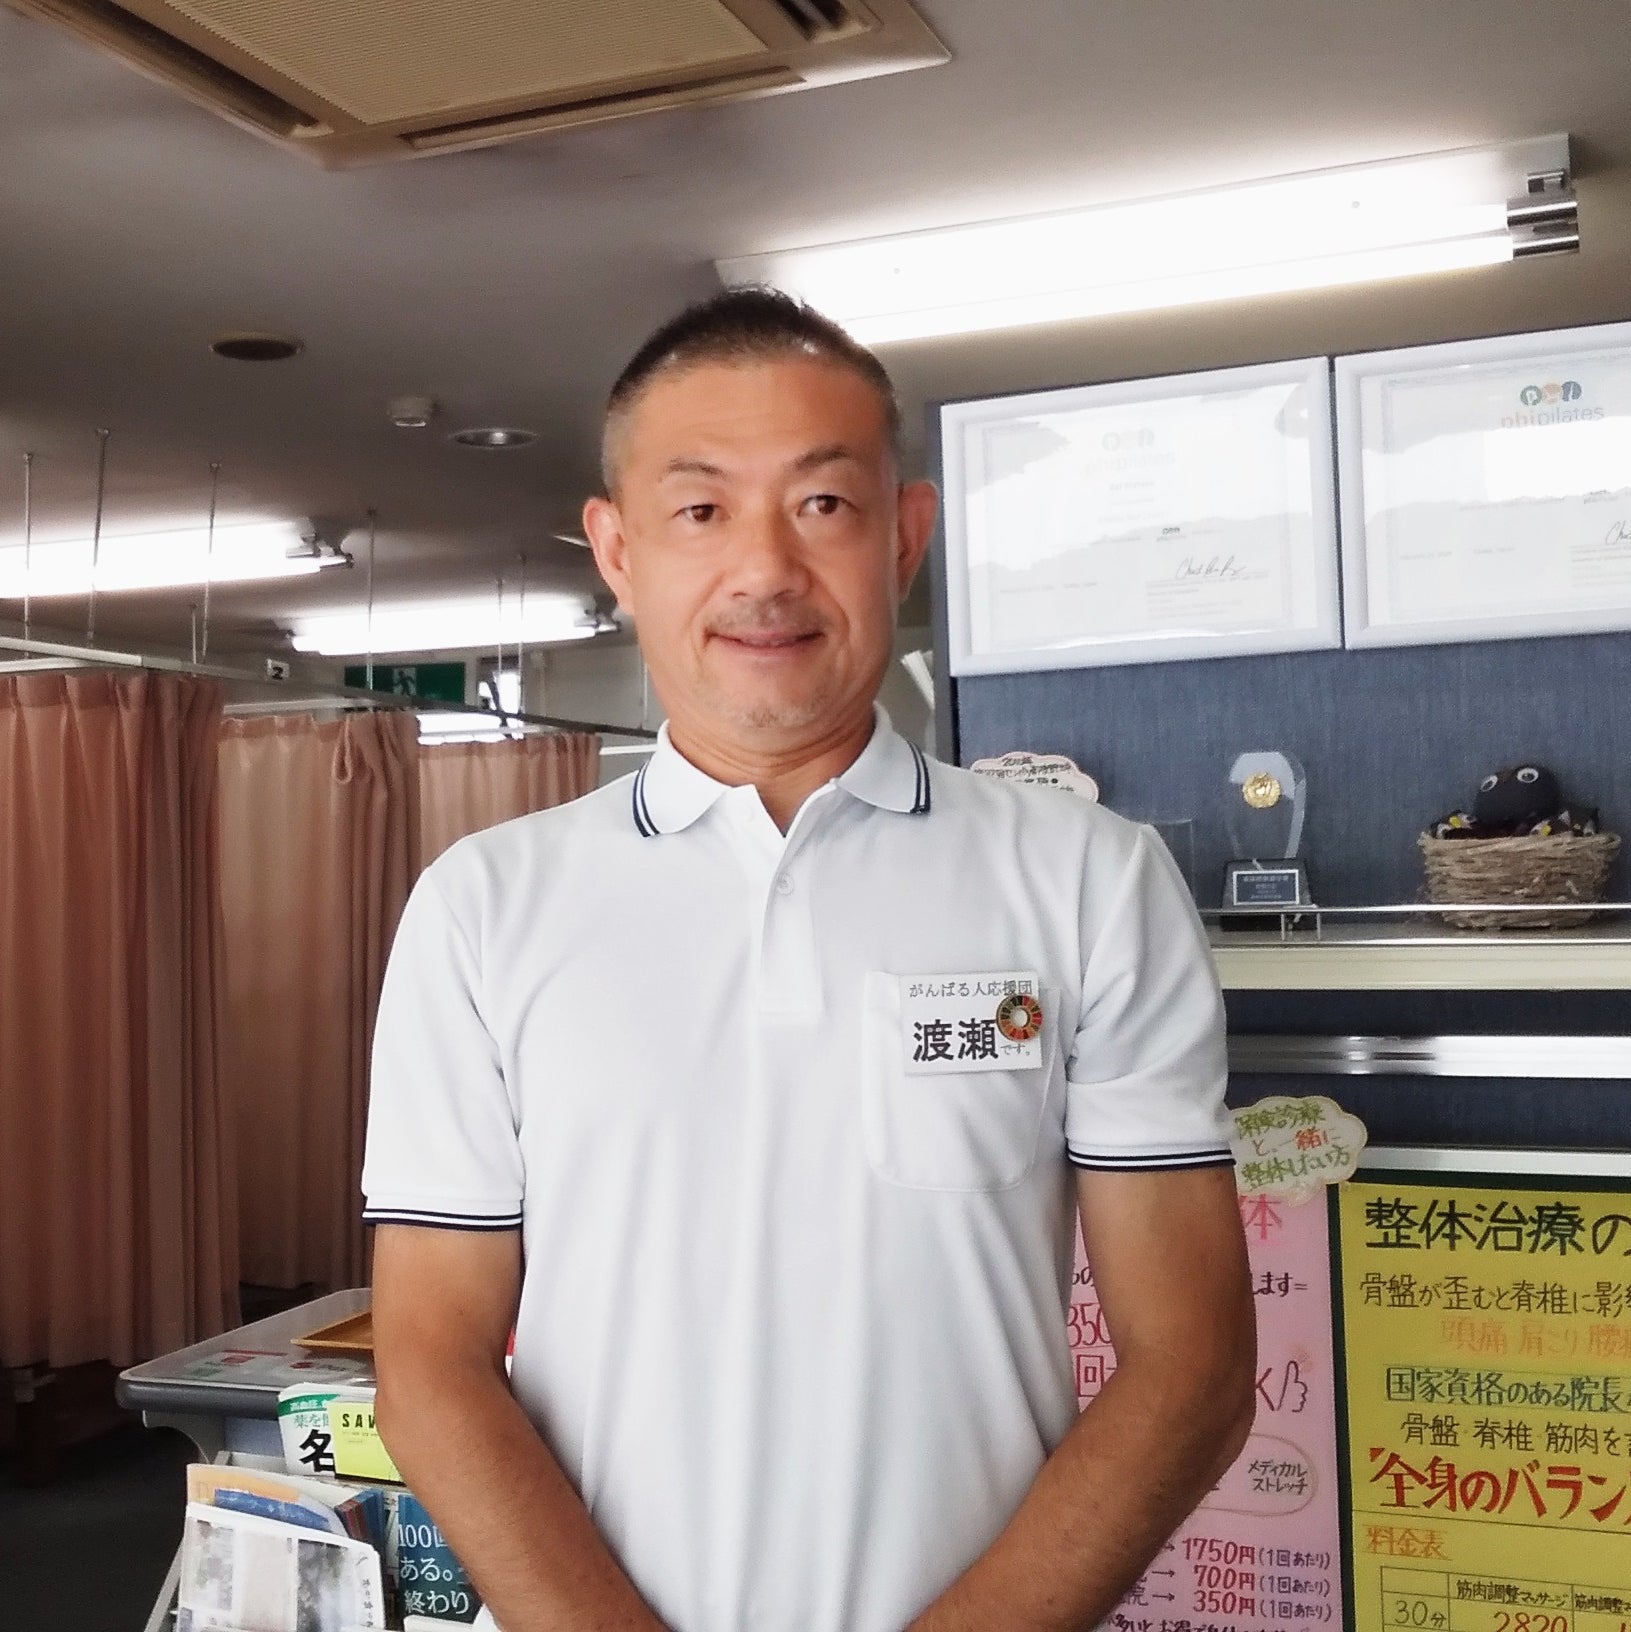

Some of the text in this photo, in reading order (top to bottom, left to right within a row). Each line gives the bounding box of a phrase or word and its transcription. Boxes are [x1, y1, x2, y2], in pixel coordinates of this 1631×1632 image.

[272, 666, 284, 680] 2
[909, 980, 1033, 998] がんばる人応援団
[913, 1018, 999, 1062] 渡瀬
[1241, 1144, 1351, 1190] 整体したい方
[1364, 1197, 1631, 1257] 整体治療の
[1077, 1355, 1115, 1397] 回
[1248, 1460, 1308, 1477] メディカル
[1253, 1478, 1308, 1495] ストレッチ
[1369, 1451, 1631, 1523] 全身のバラン
[404, 1589, 470, 1615] 終わり
[1394, 1600, 1447, 1627] 30分
